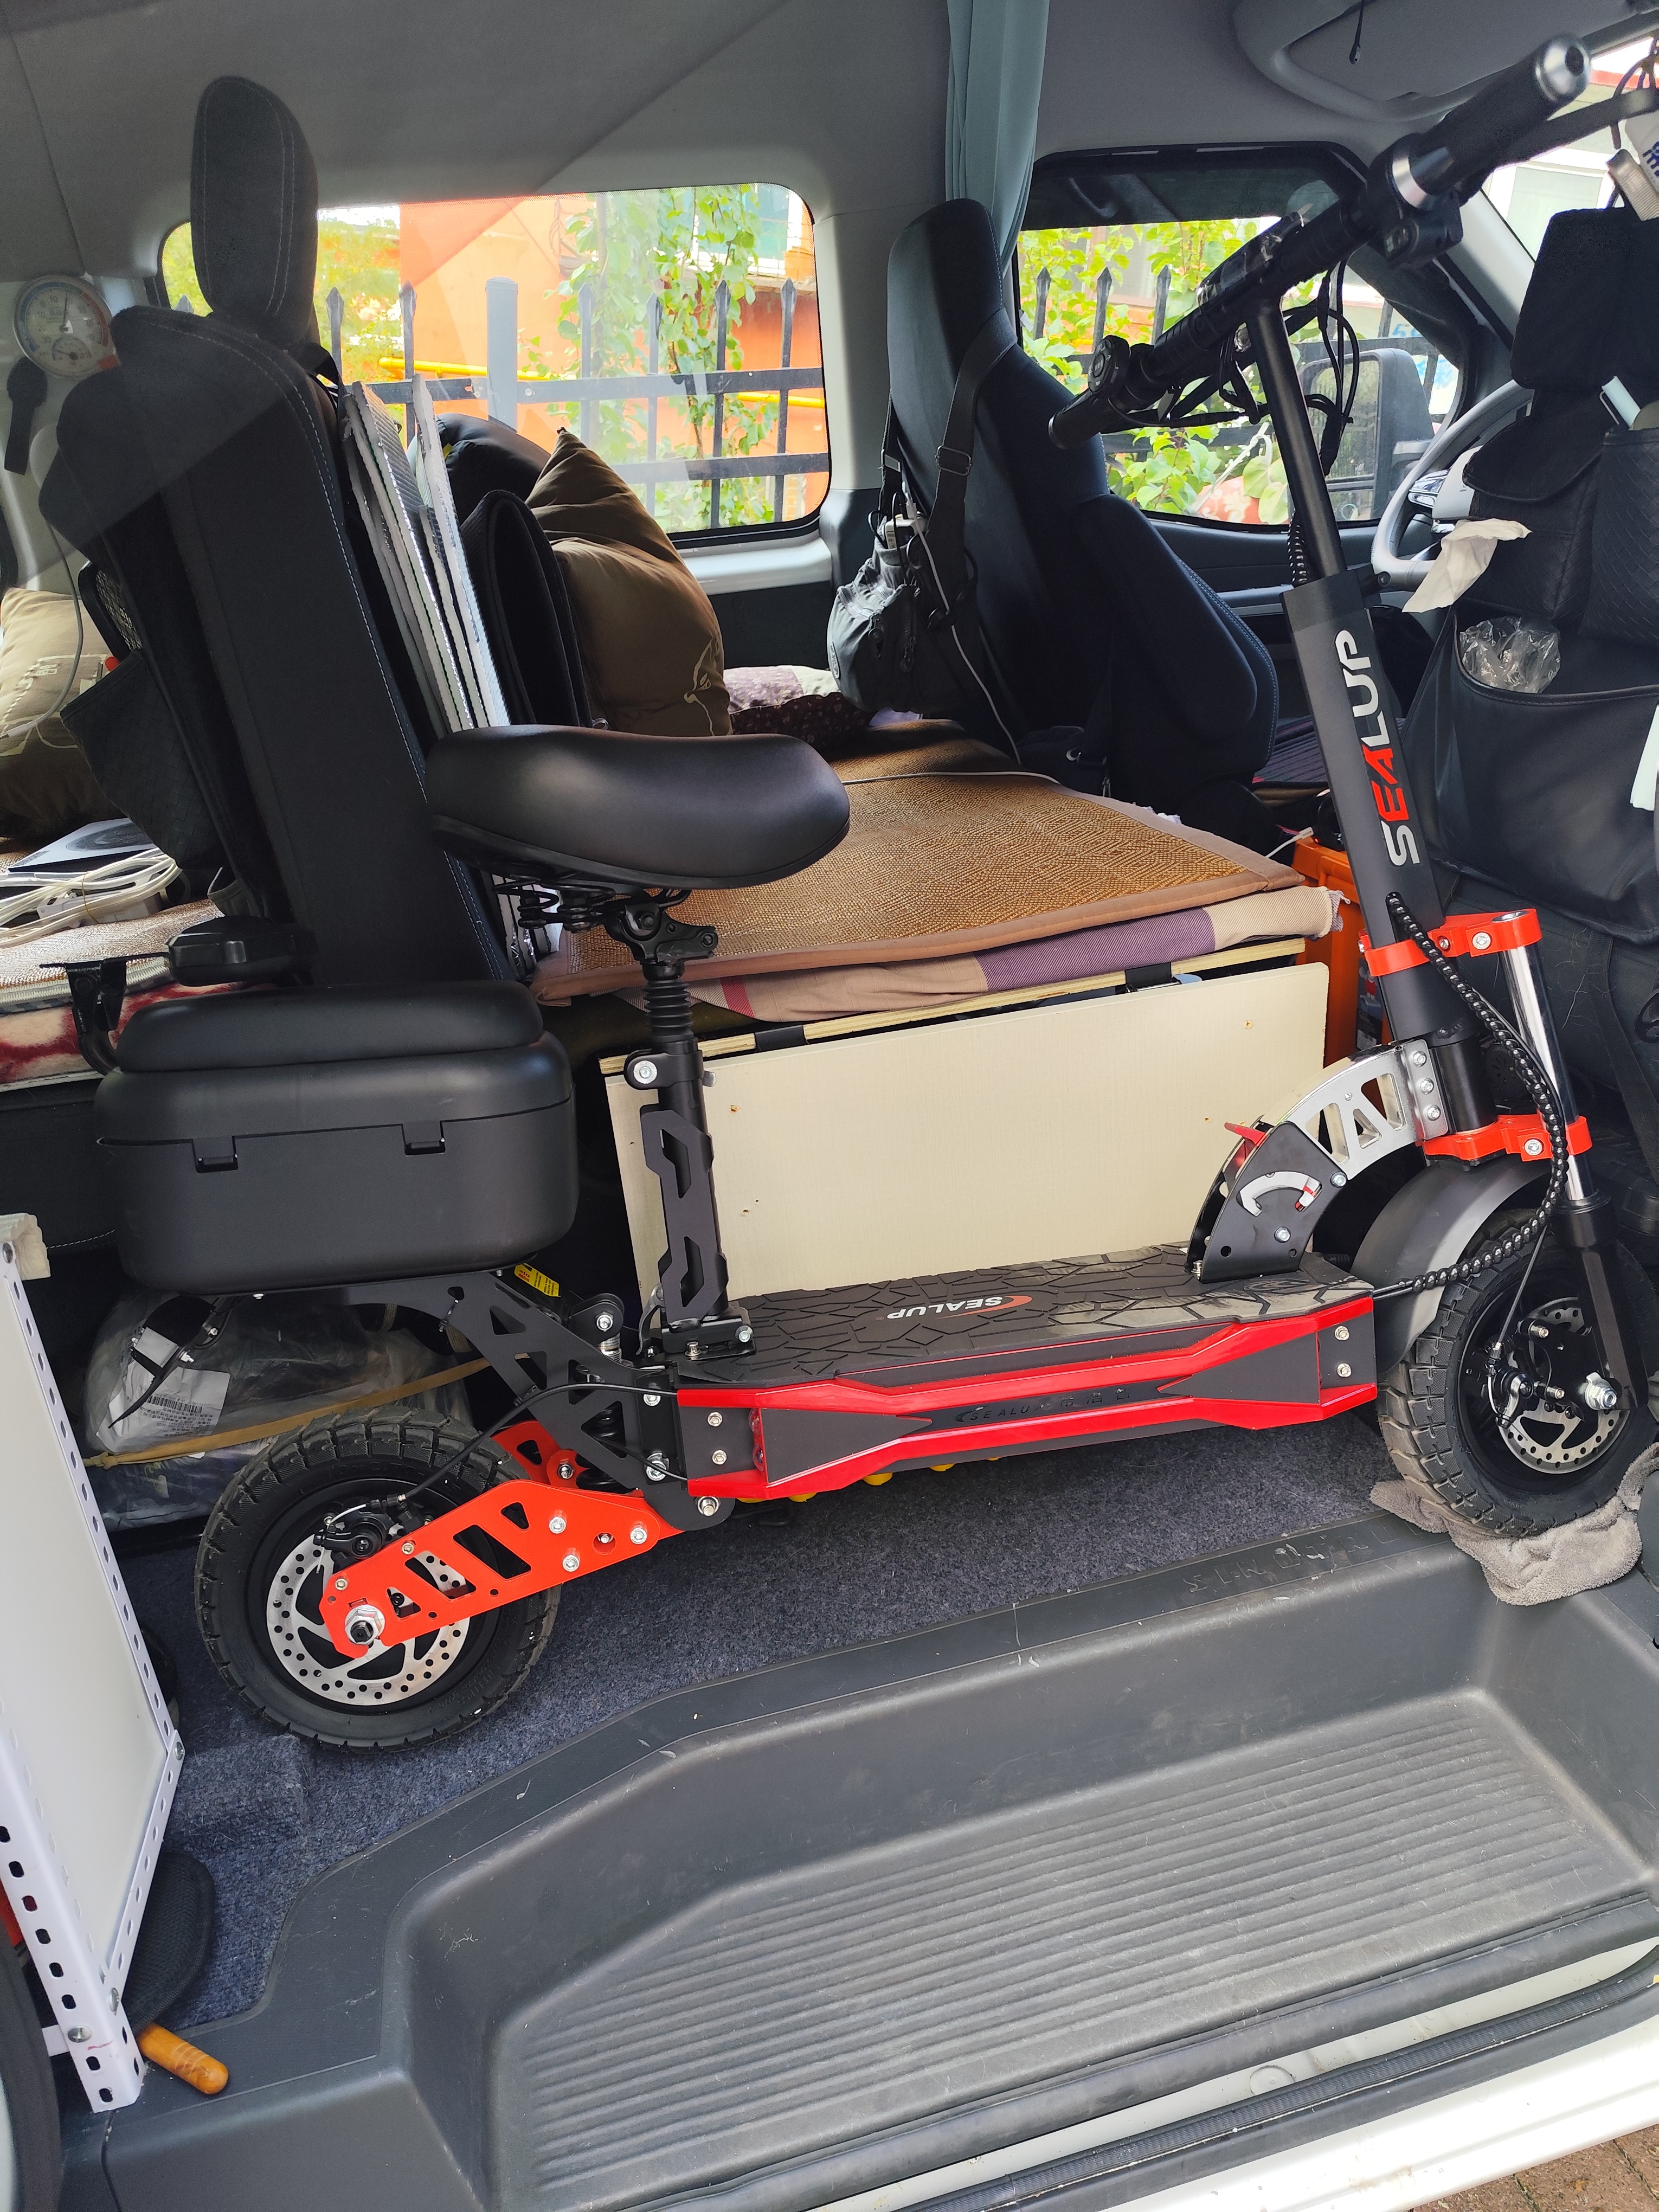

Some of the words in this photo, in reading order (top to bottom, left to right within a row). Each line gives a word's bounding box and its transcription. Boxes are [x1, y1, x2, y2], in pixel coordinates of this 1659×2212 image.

[1335, 629, 1421, 866] SEALUP
[886, 1296, 1004, 1319] SEALUP
[969, 1403, 1044, 1420] SEALUP
